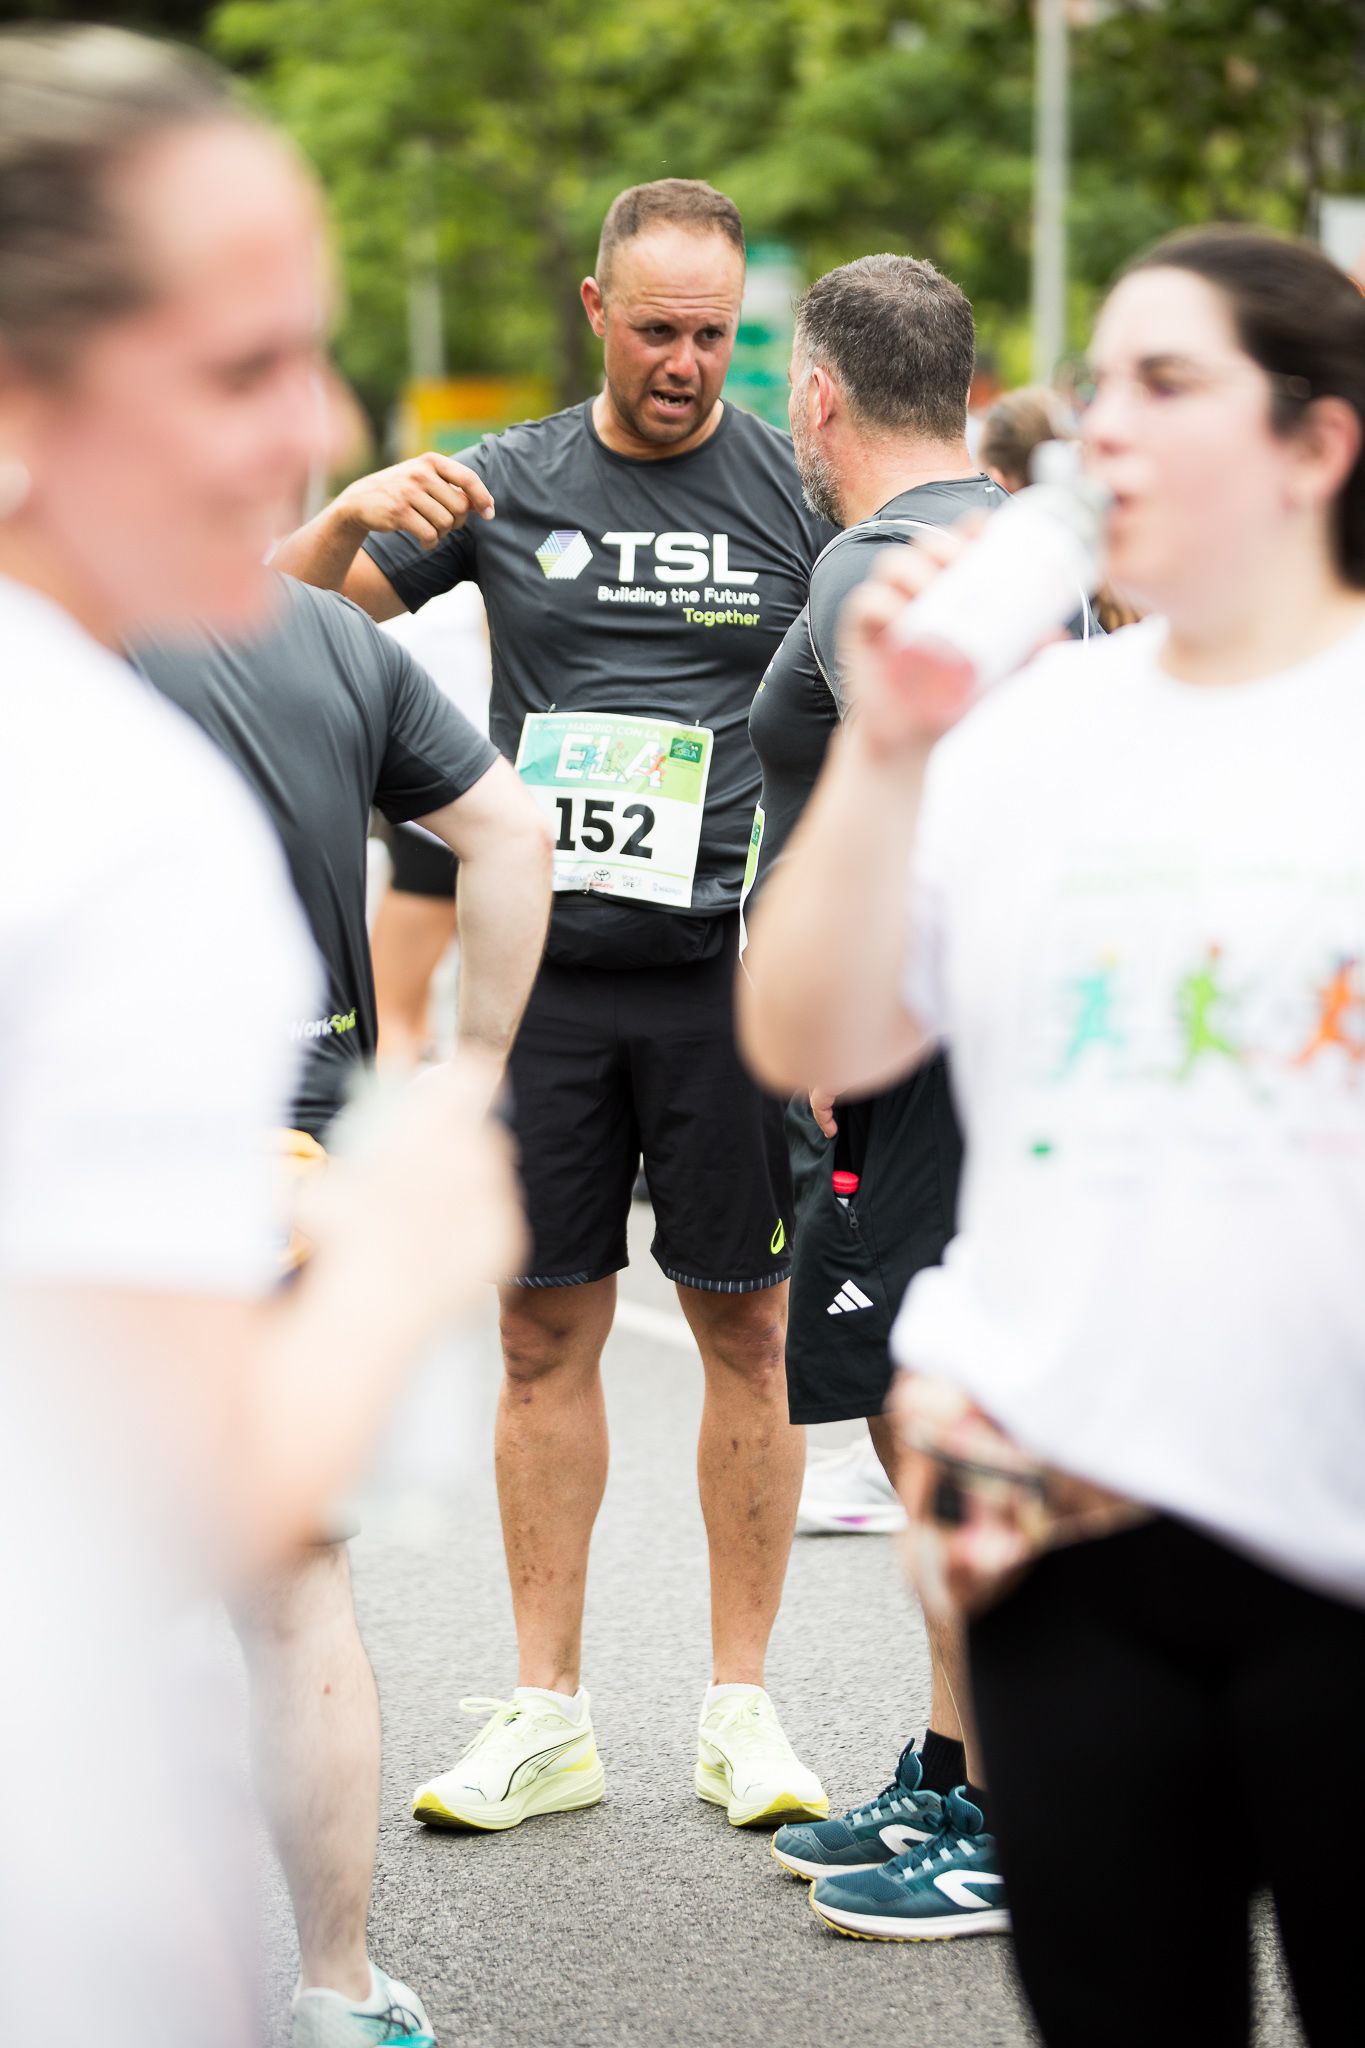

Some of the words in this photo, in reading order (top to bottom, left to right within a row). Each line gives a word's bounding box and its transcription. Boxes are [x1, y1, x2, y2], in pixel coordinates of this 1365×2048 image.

[601, 531, 759, 585] TSL
[597, 585, 667, 606] Building
[670, 587, 700, 603] the
[704, 587, 760, 605] Future
[682, 607, 760, 627] Together
[555, 733, 662, 788] ELA
[555, 797, 656, 860] 152
